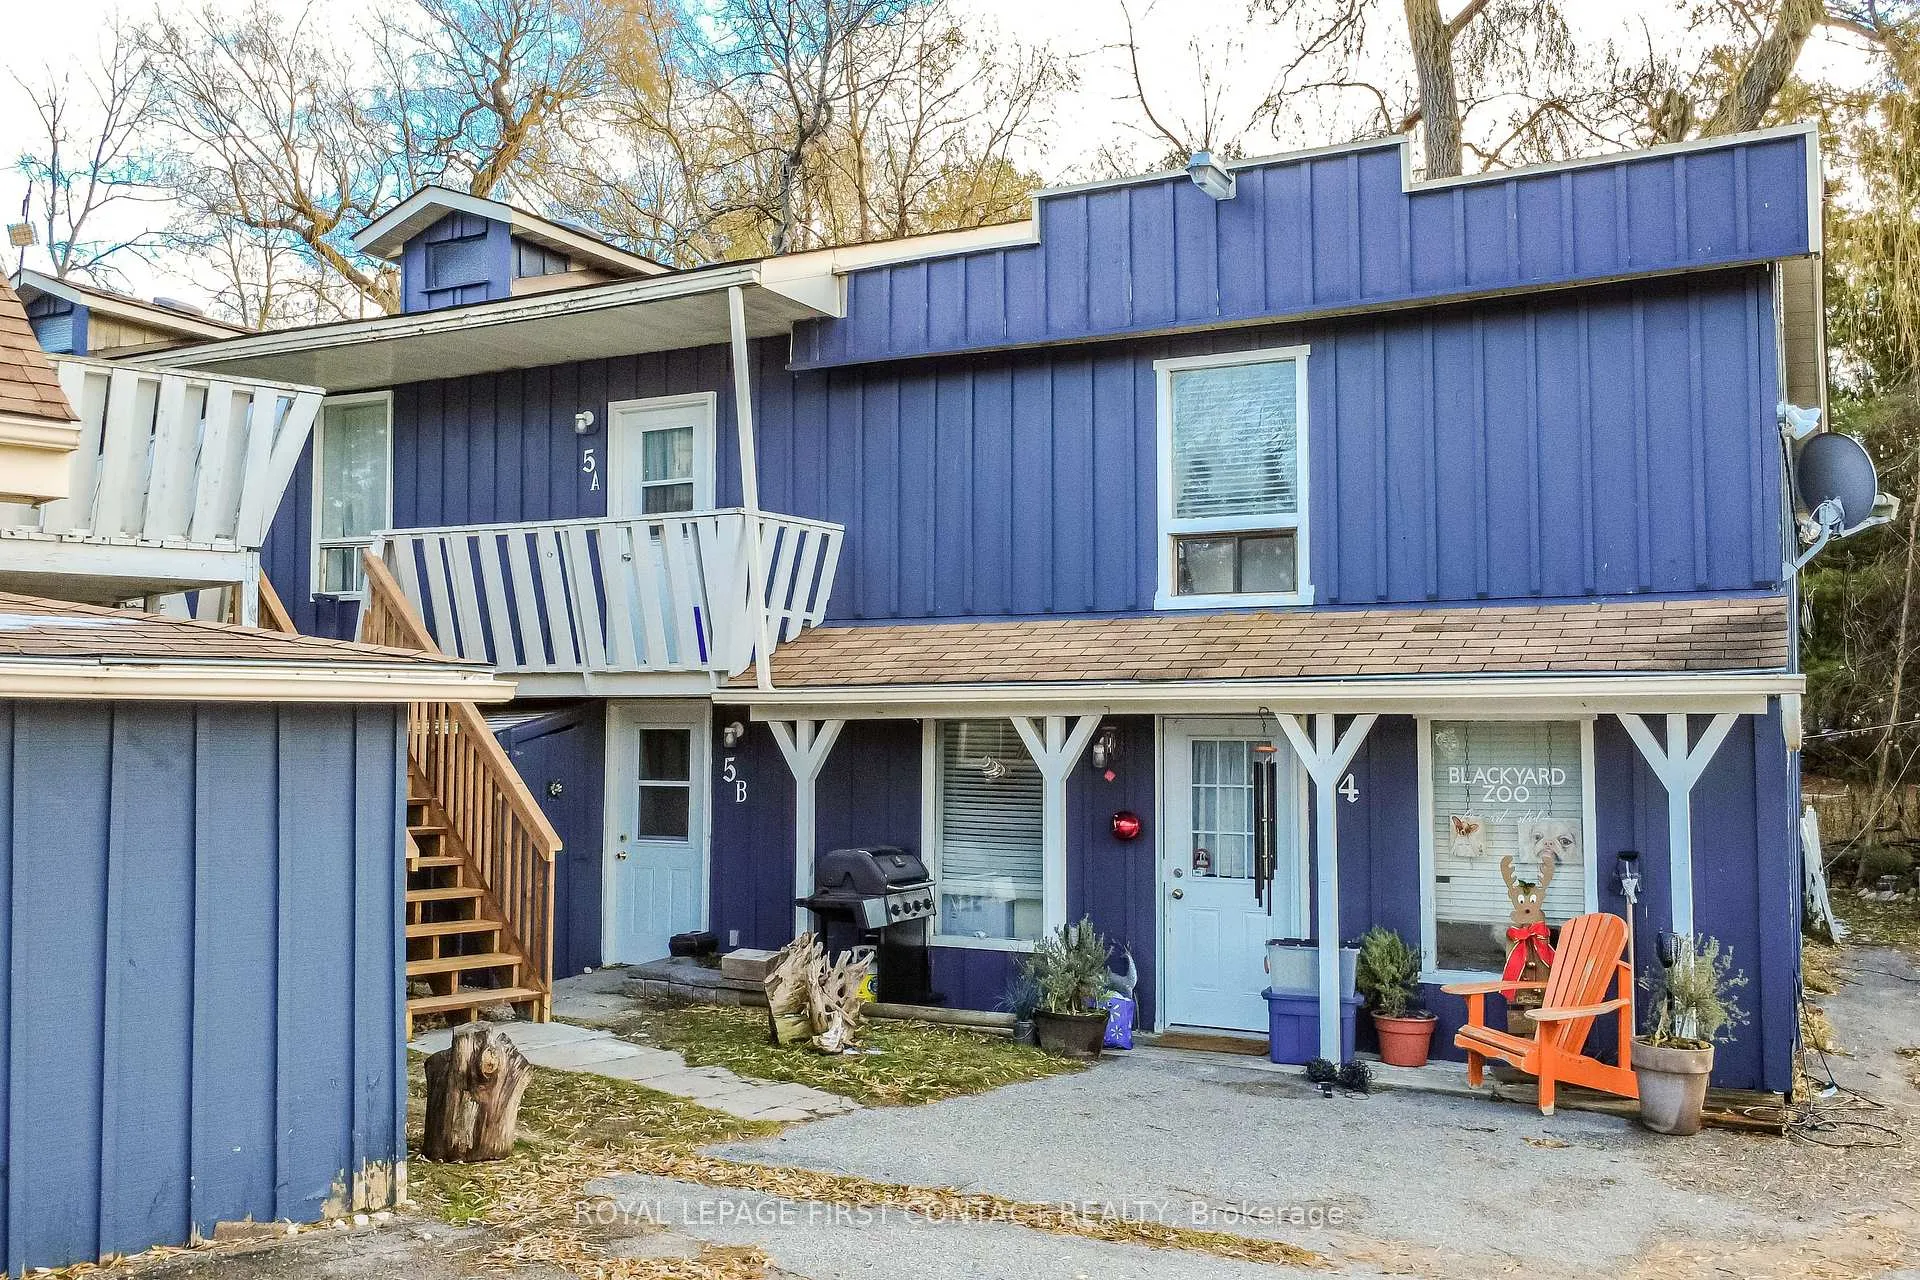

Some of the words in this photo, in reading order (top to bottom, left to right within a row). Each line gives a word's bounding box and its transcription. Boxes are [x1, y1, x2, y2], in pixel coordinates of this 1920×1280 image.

[582, 448, 596, 473] 5
[589, 470, 600, 491] A
[722, 756, 737, 783] 5
[1449, 766, 1566, 785] BLACKYARD
[735, 780, 747, 803] B
[1338, 773, 1360, 803] 4
[1482, 785, 1530, 803] ZOO
